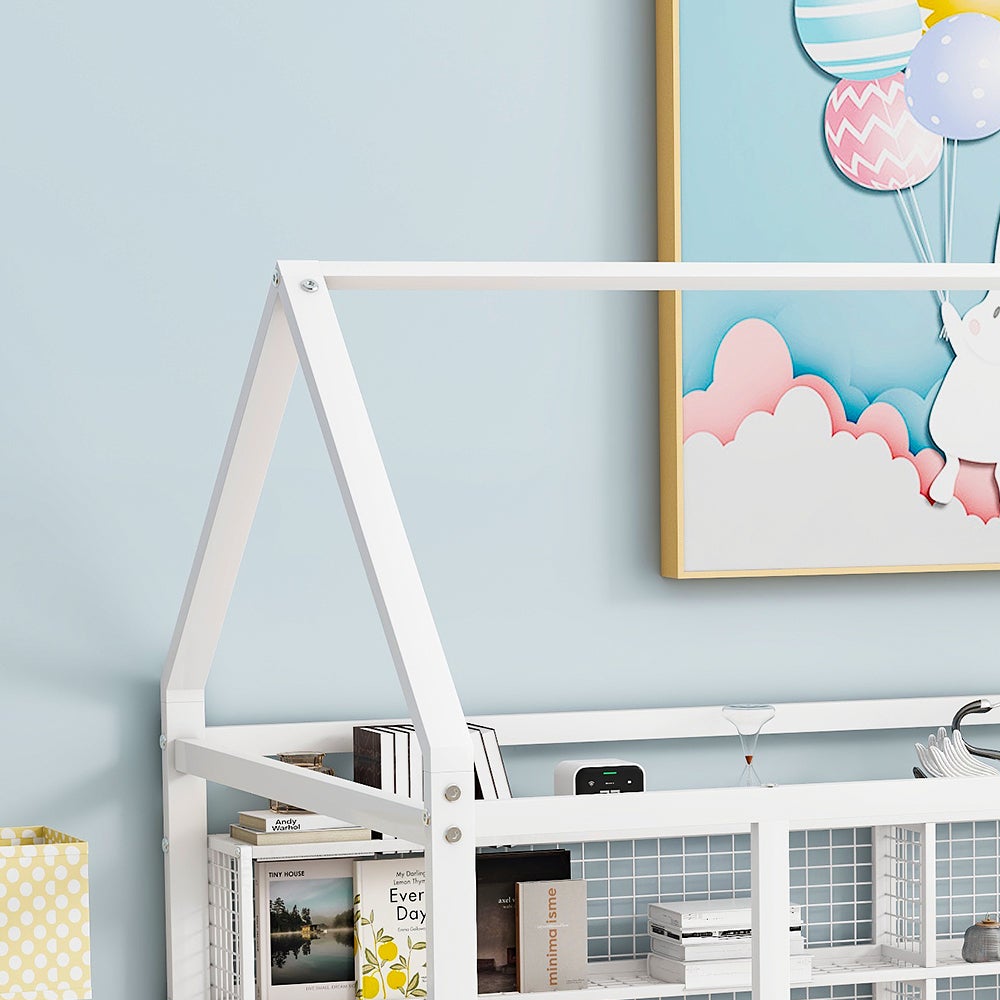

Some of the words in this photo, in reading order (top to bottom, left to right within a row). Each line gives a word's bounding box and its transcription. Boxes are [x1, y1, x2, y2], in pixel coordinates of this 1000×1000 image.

[275, 818, 297, 826] Andy
[390, 887, 424, 902] Ever
[397, 905, 426, 924] Day
